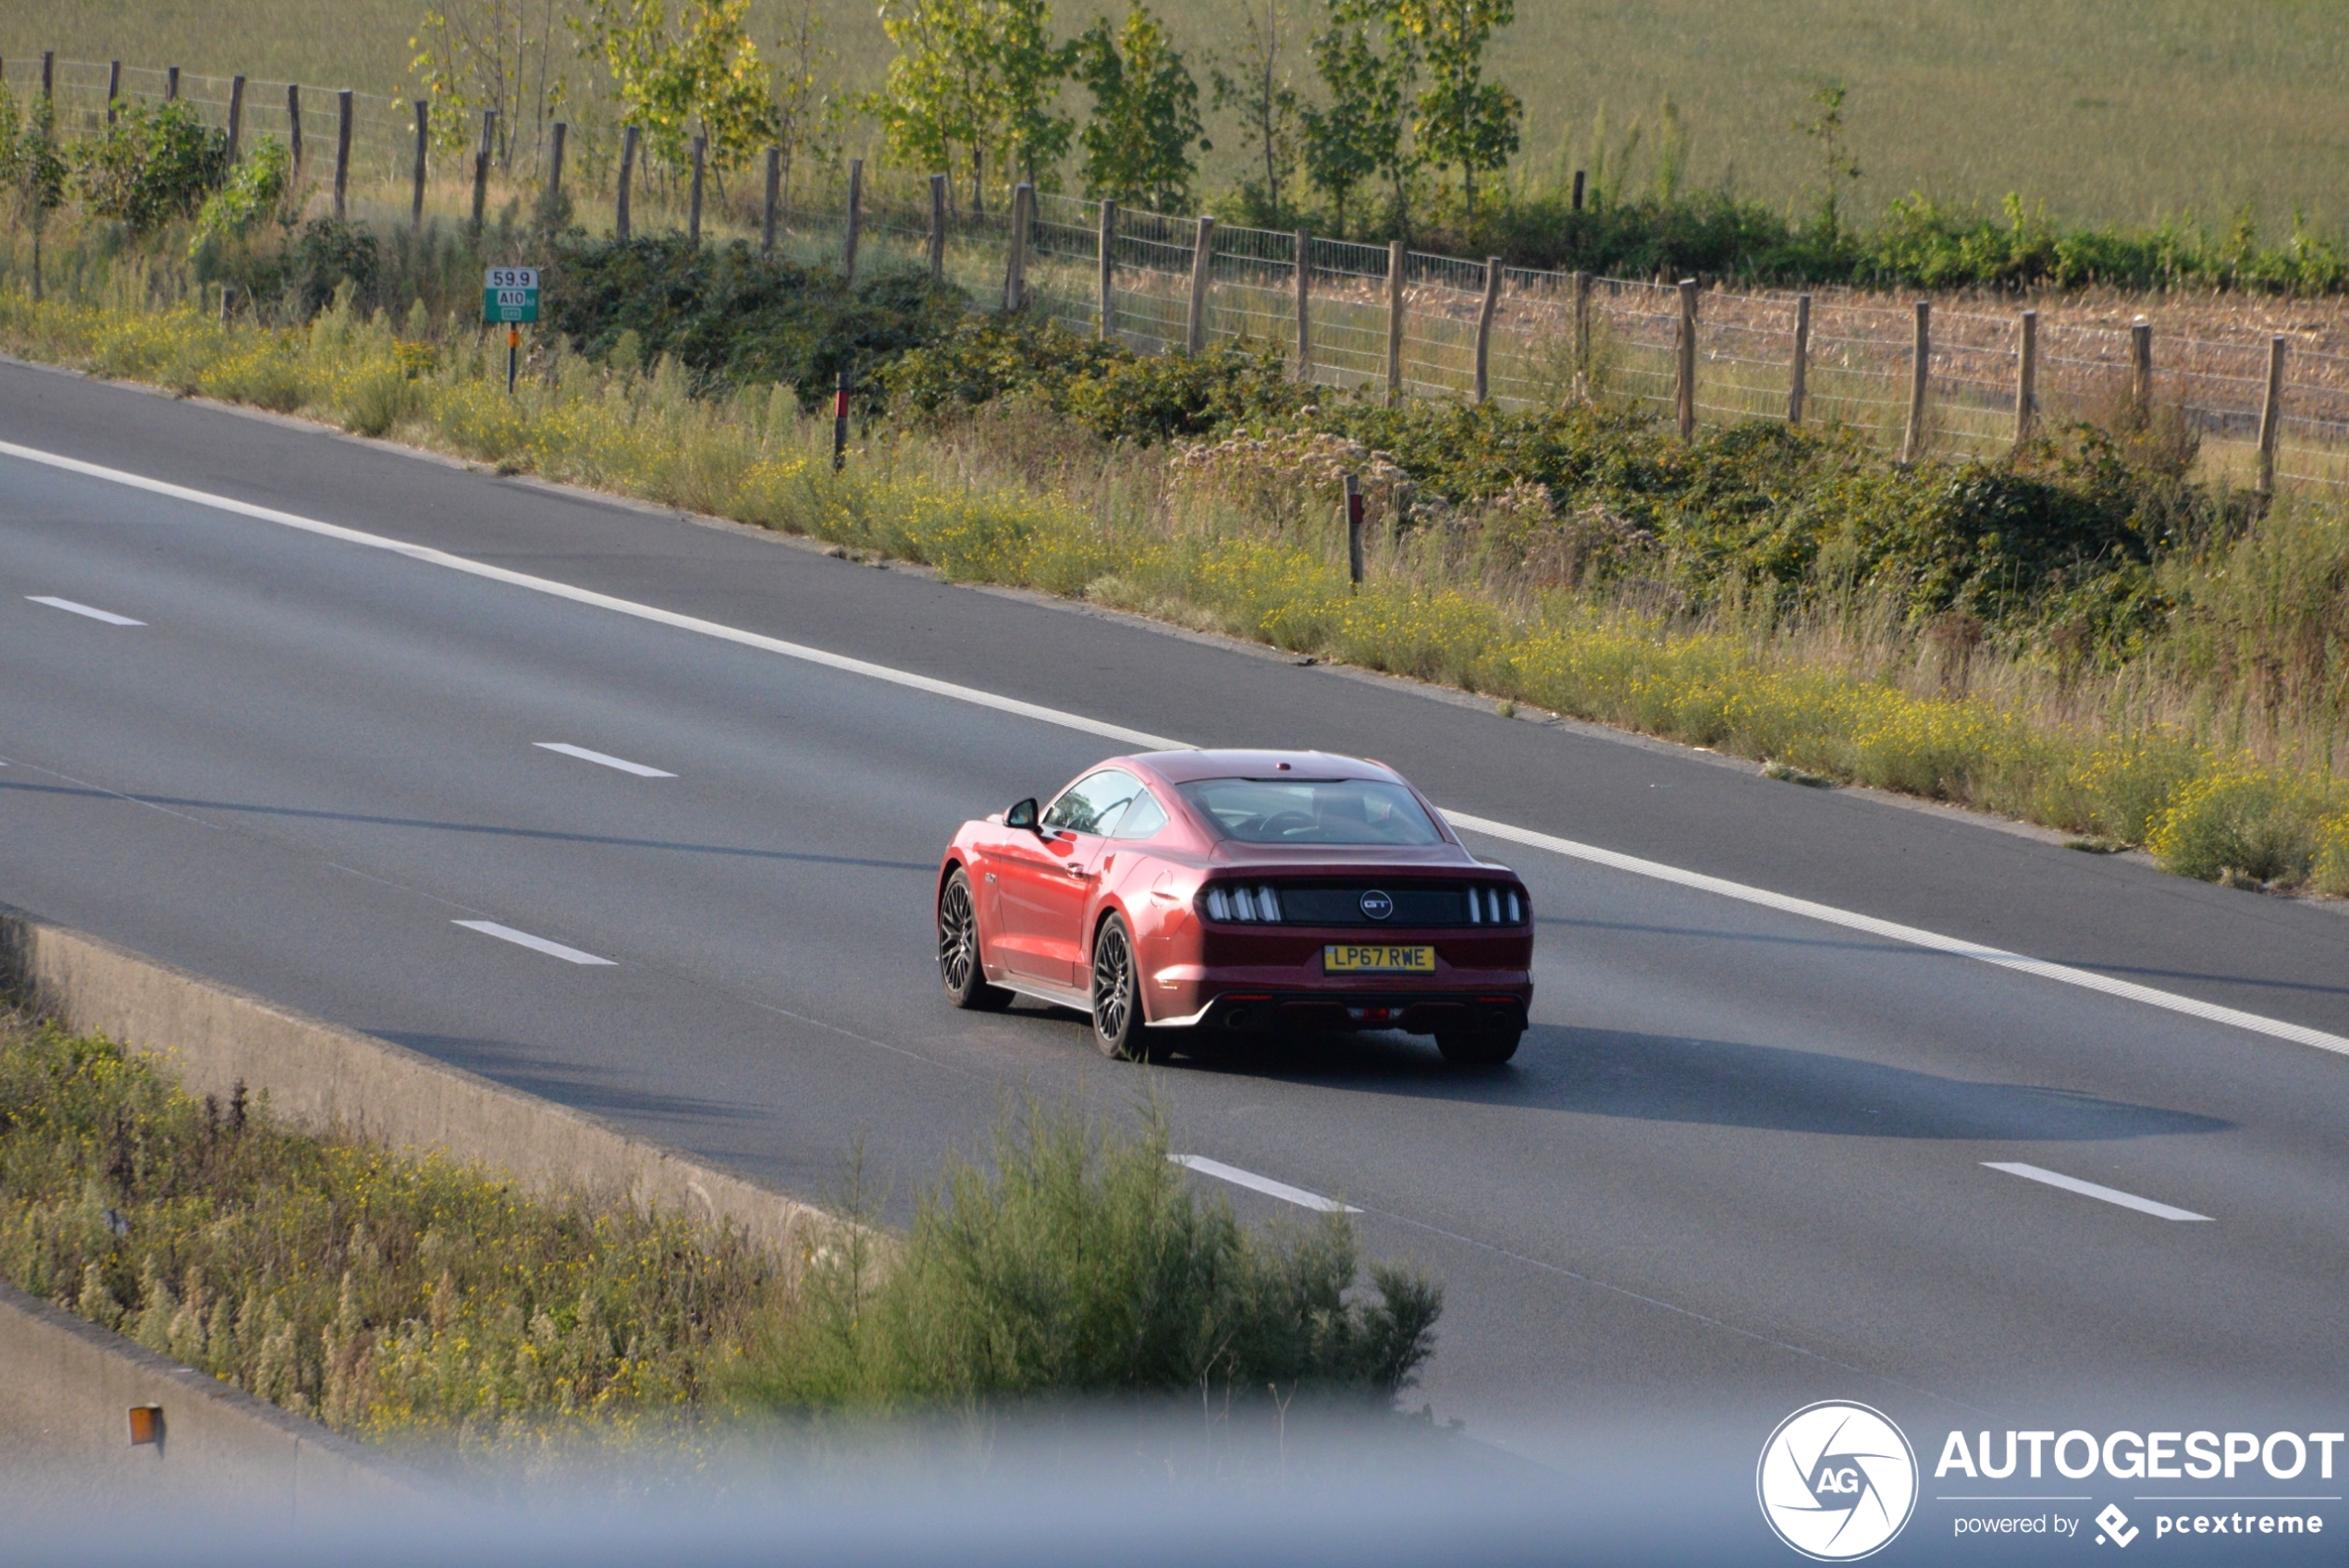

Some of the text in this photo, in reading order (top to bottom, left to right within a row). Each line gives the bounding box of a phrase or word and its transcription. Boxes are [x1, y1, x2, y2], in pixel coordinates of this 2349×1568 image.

[494, 271, 530, 287] 59.9
[500, 292, 523, 304] A10
[1334, 948, 1425, 966] LP67 RWE
